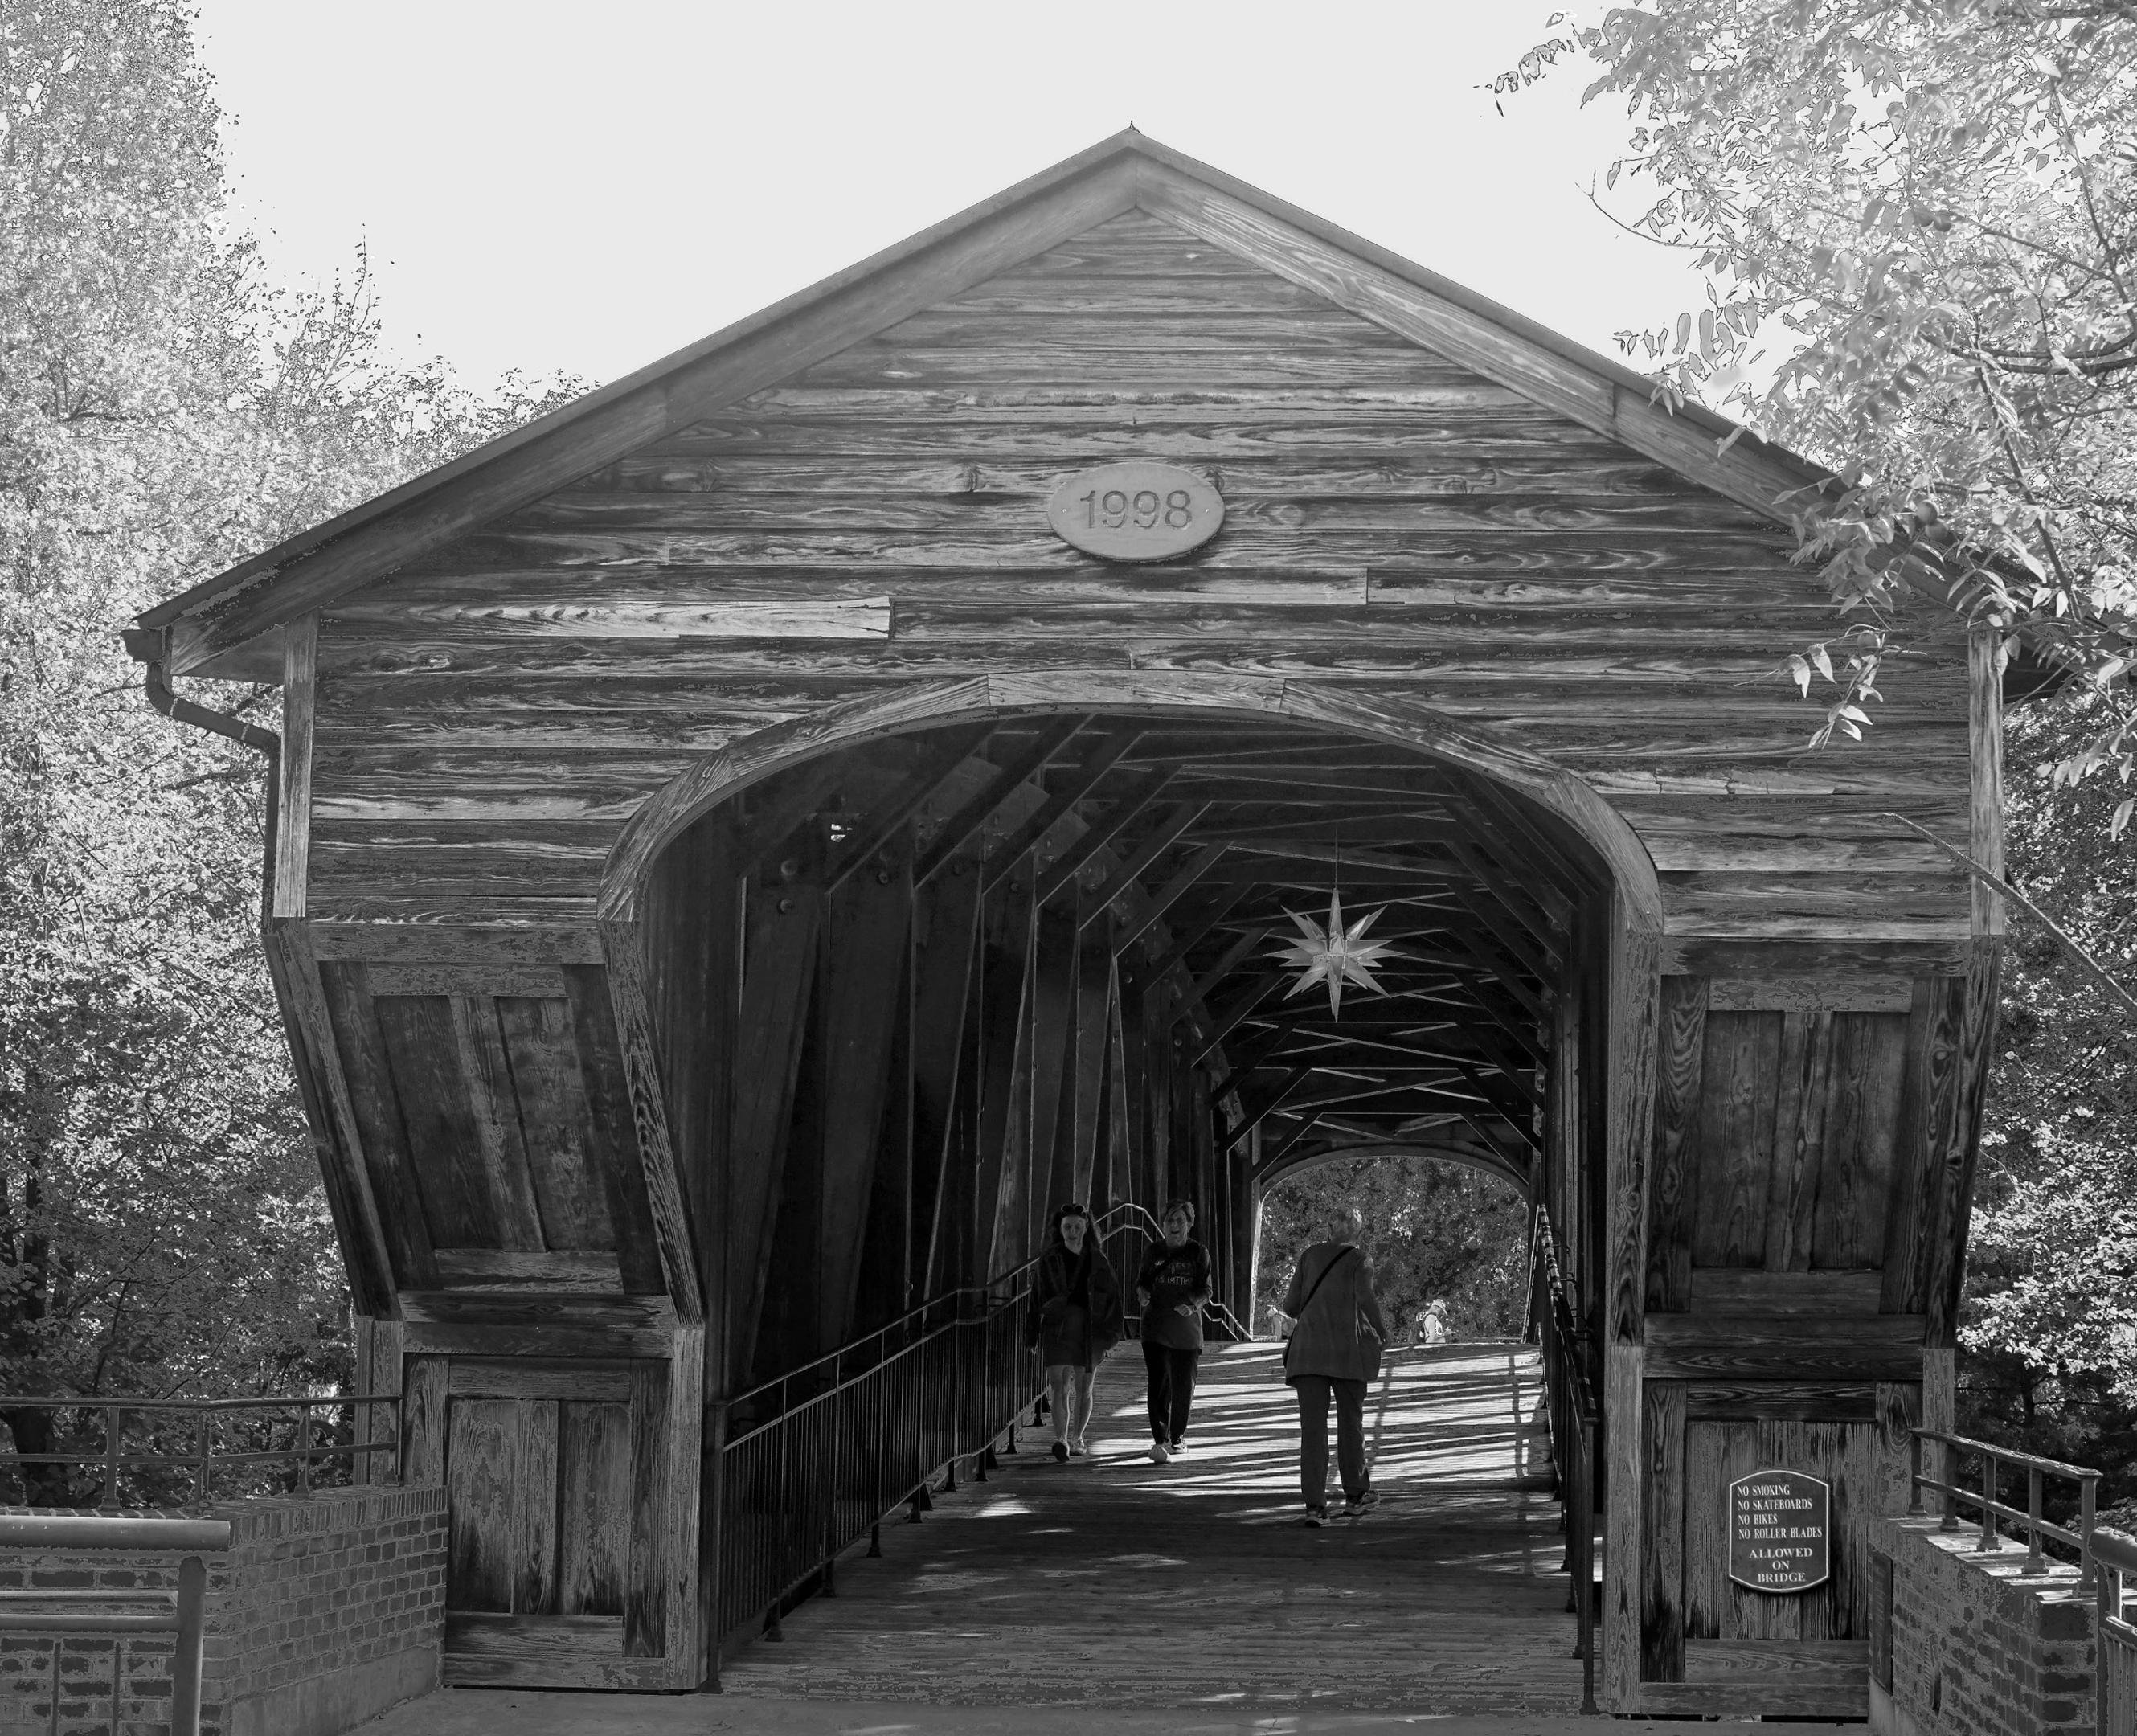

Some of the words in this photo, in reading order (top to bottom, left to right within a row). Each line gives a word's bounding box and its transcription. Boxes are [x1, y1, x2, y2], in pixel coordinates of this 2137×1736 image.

[1080, 490, 1192, 529] 1998
[1737, 1485, 1749, 1497] NO
[1752, 1484, 1790, 1496] SMOKING
[1738, 1500, 1750, 1511] NO
[1753, 1498, 1812, 1510] SKATEBOARDS
[1738, 1514, 1750, 1525] NO
[1754, 1513, 1778, 1525] BIKES
[1738, 1529, 1750, 1540] NO
[1754, 1527, 1787, 1539] ROLLER
[1791, 1526, 1822, 1538] BLADES
[1749, 1547, 1813, 1558] ALLOWED
[1771, 1560, 1790, 1570] ON
[1758, 1572, 1806, 1583] BRIDGE
